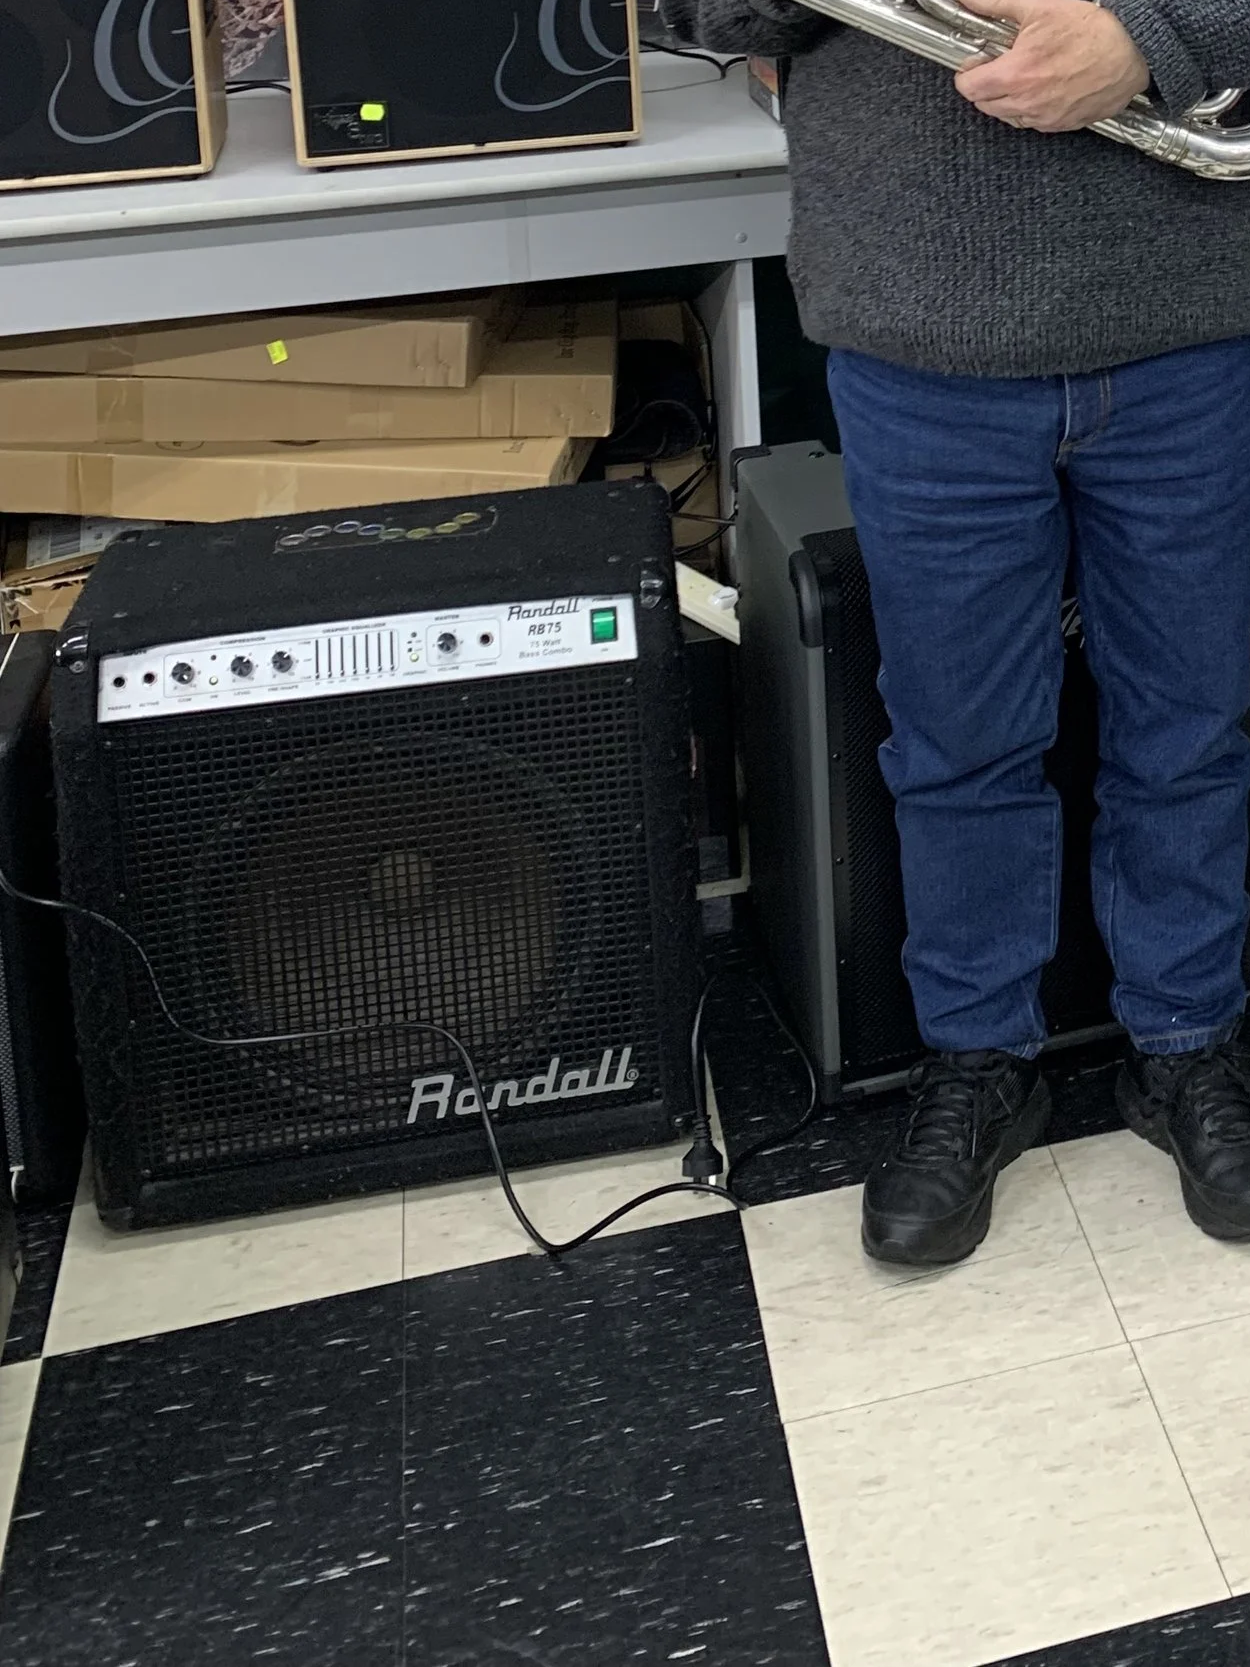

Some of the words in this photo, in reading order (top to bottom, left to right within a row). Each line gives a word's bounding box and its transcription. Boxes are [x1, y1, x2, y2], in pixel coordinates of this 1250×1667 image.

[507, 597, 581, 622] Randall
[528, 621, 562, 636] RB75
[542, 638, 562, 648] Watt
[519, 650, 540, 659] Bass
[542, 647, 573, 657] Combo
